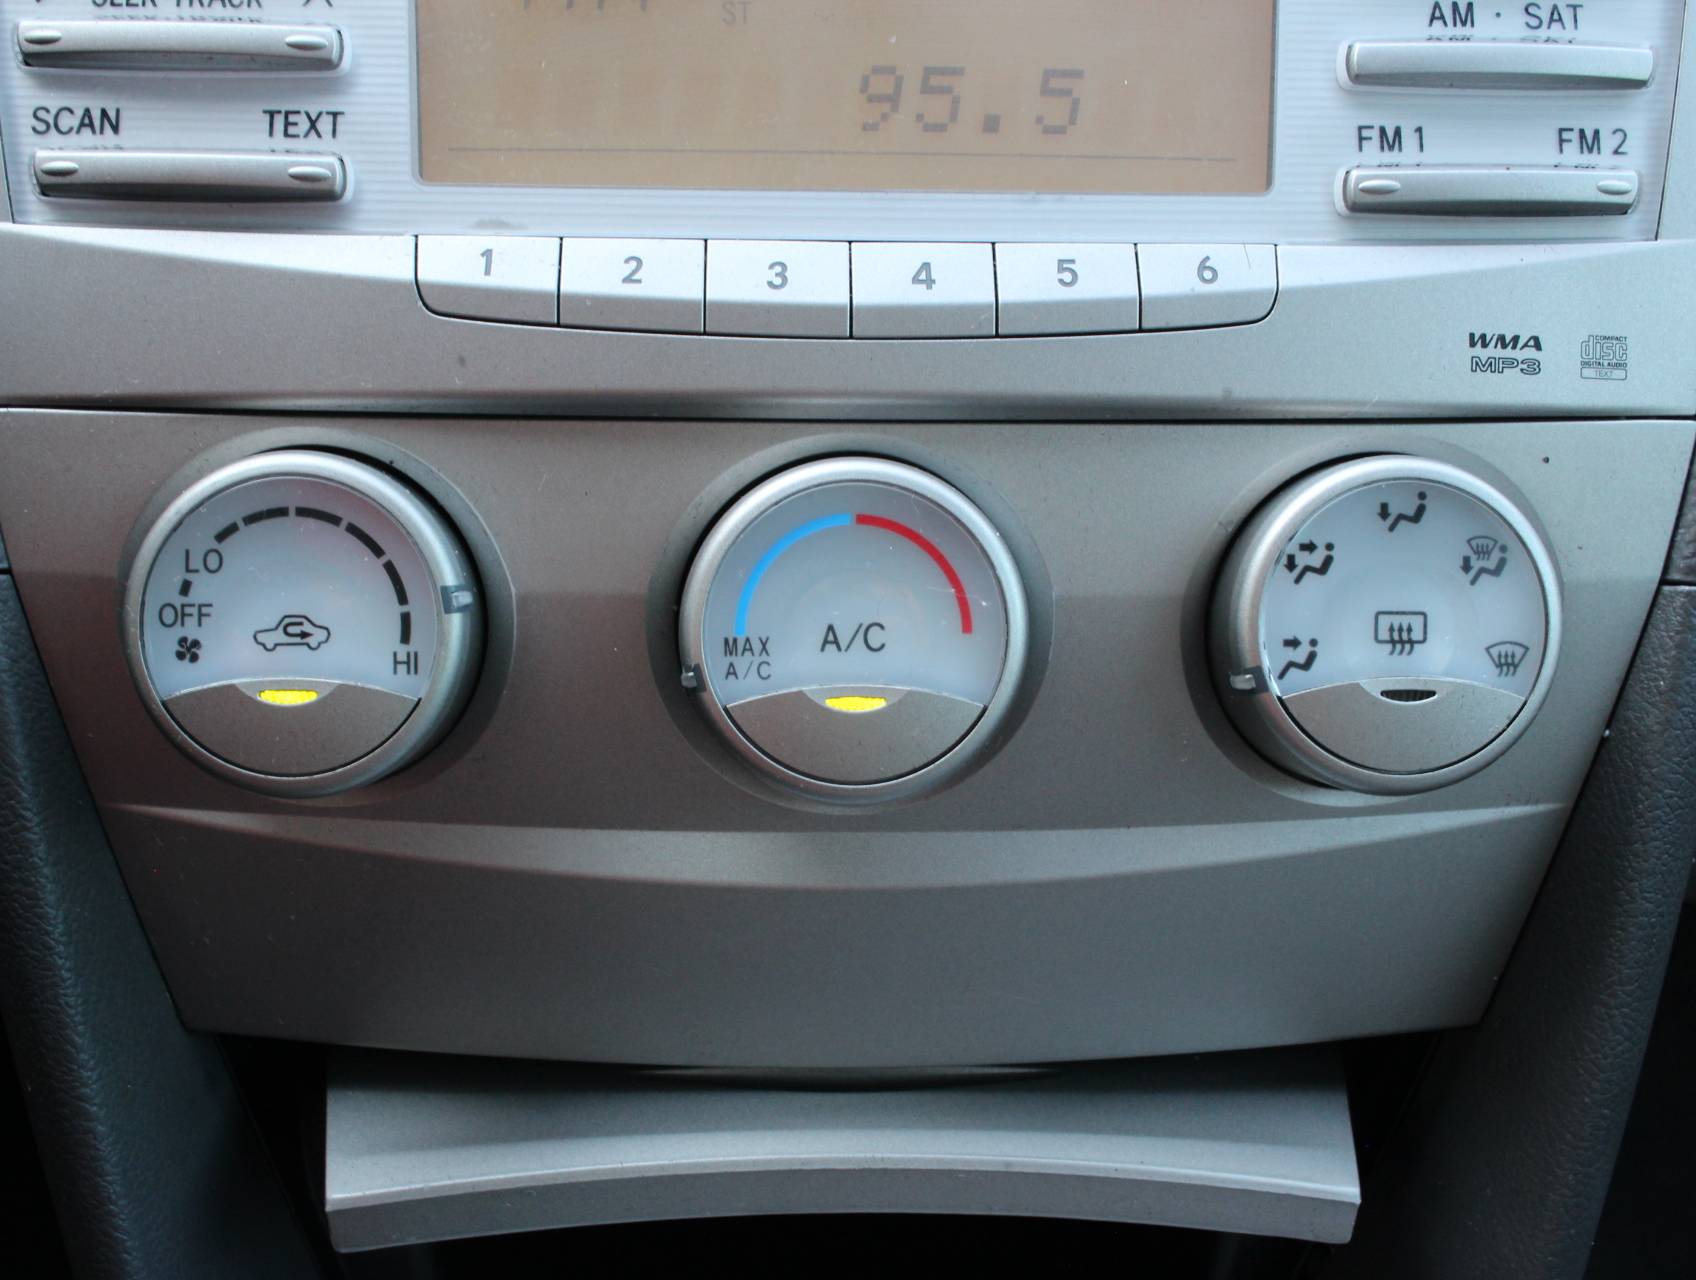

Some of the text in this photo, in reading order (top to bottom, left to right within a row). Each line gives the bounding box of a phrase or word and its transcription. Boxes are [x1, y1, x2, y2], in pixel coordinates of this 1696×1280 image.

[722, 1, 749, 24] ST
[1428, 1, 1583, 30] AM SAT
[859, 65, 1085, 134] 95.5
[31, 106, 121, 136] SCAN
[262, 109, 345, 138] TEXT
[479, 248, 494, 277] 1
[621, 256, 644, 284] 2
[766, 261, 789, 290] 3
[911, 262, 936, 290] 4
[1056, 259, 1079, 287] 5
[1197, 256, 1219, 284] 6
[1468, 332, 1543, 351] WMA
[1471, 356, 1541, 375] MP3
[1580, 360, 1628, 369] DIGITAL AUDIO
[184, 549, 224, 574] LO
[158, 603, 214, 628] OFF
[723, 636, 770, 657] MAX
[819, 622, 887, 652] A/C
[392, 651, 419, 675] HI
[724, 660, 772, 681] A/C
